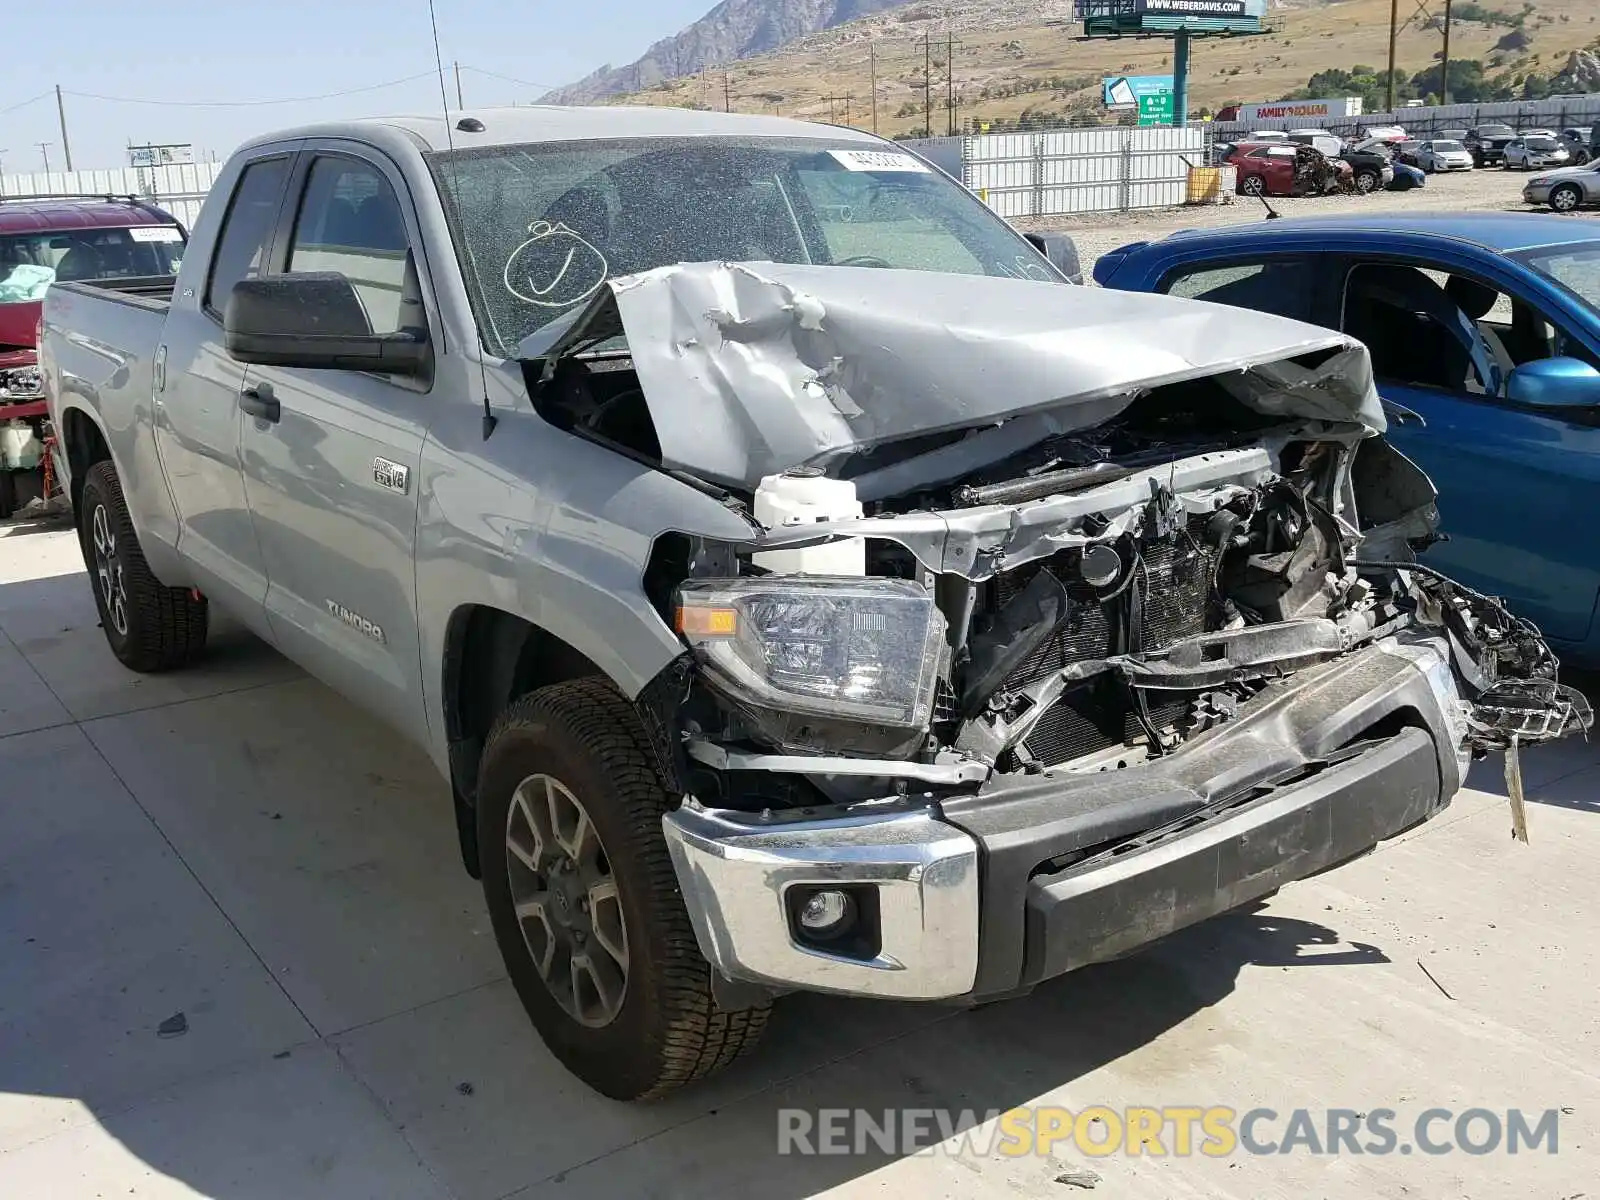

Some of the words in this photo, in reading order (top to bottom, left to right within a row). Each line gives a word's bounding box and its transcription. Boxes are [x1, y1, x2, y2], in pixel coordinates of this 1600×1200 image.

[1146, 0, 1240, 12] WWW.WEBERDAVIS.COM
[1257, 107, 1286, 118] FAMILY
[326, 599, 384, 642] TUNDRA
